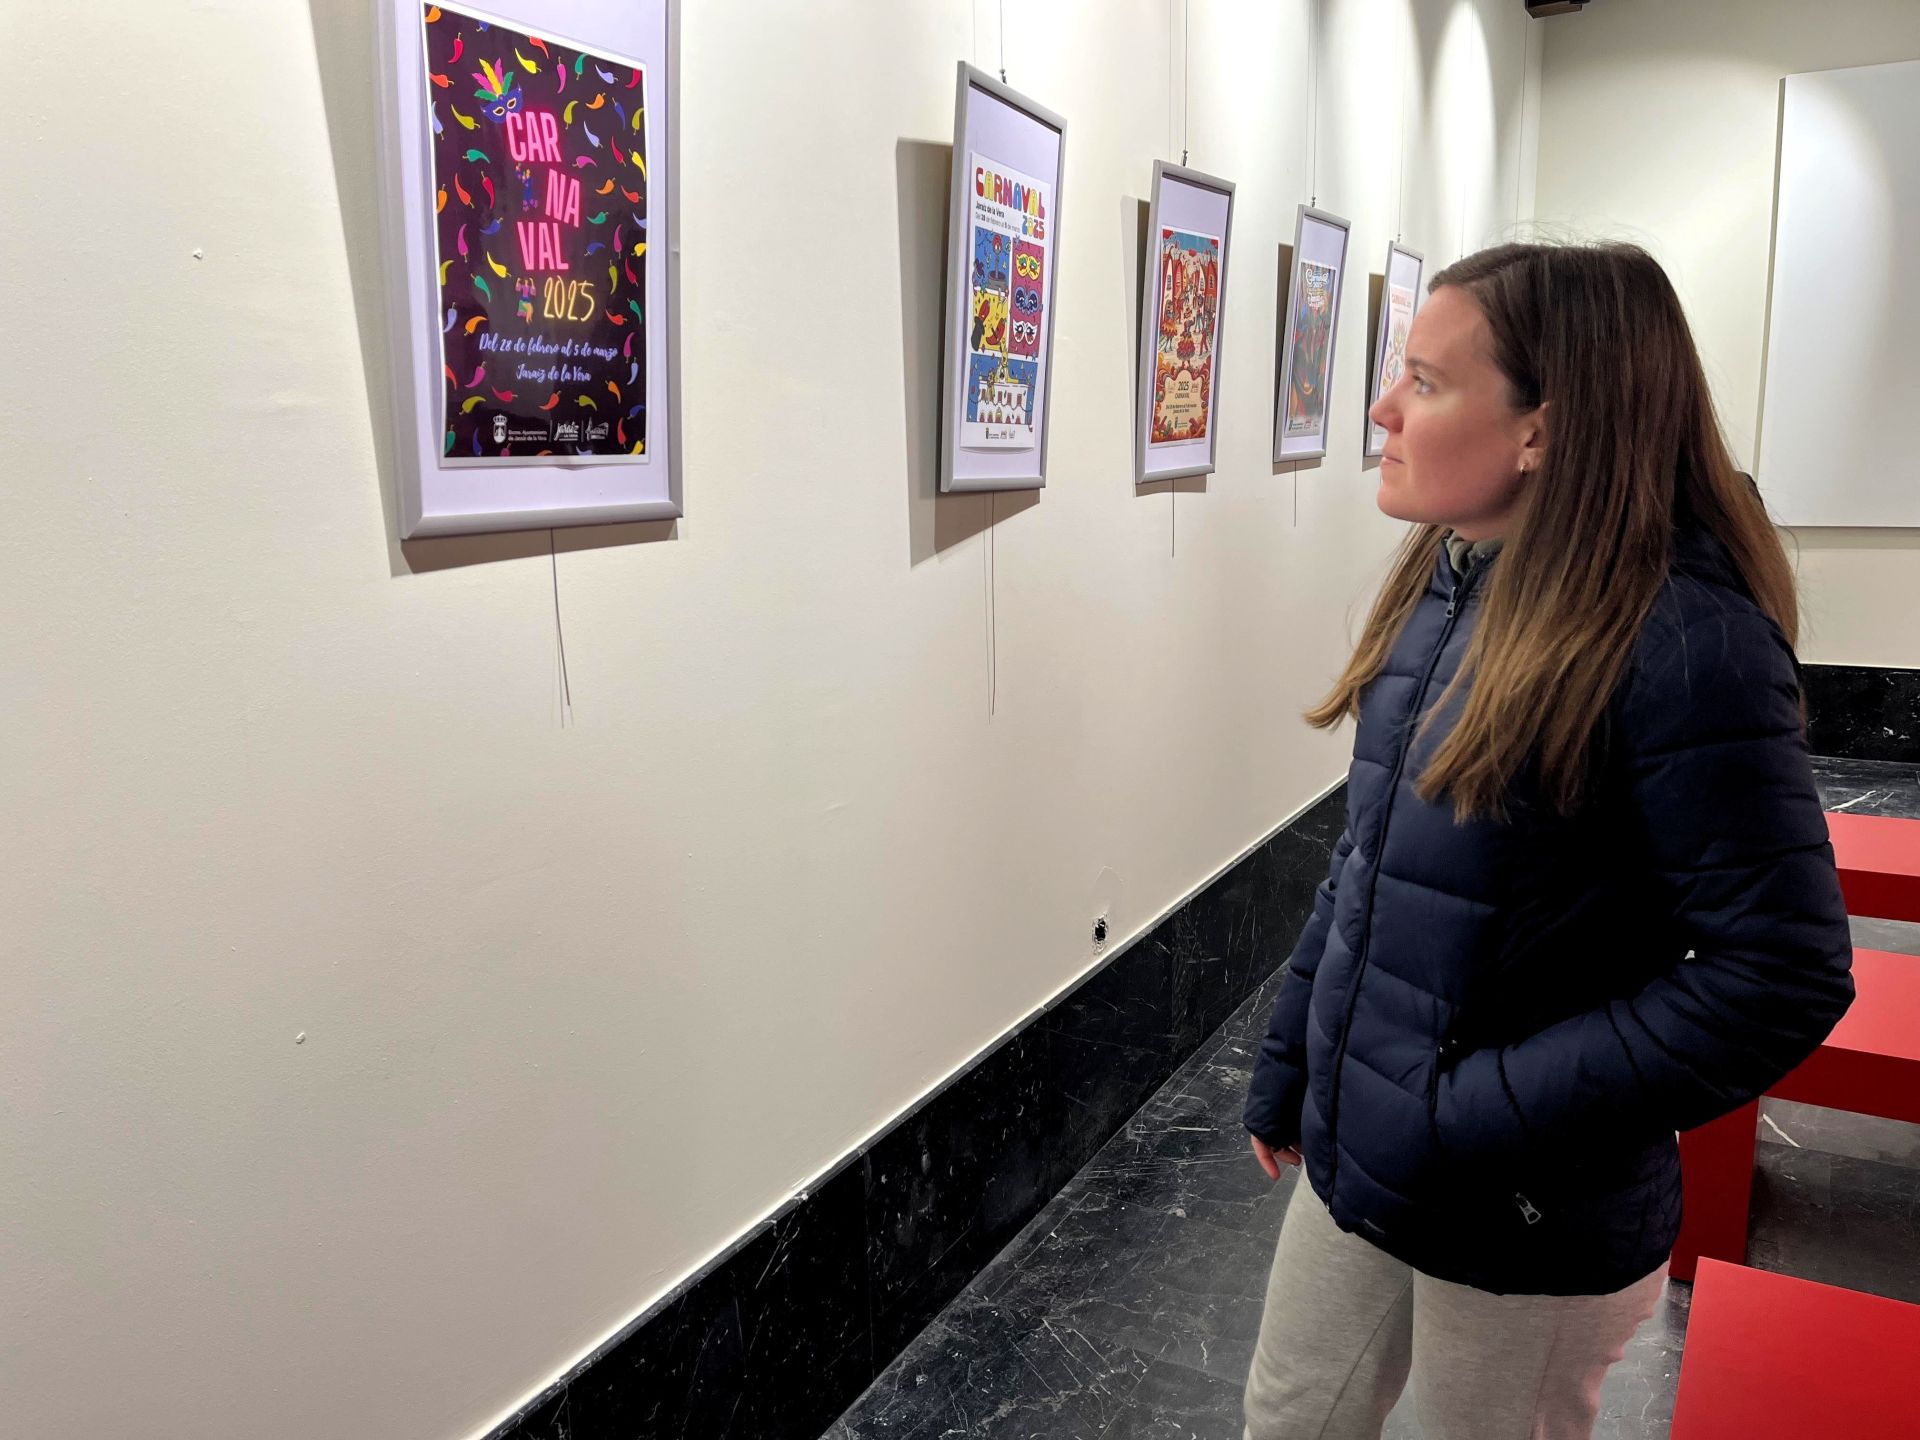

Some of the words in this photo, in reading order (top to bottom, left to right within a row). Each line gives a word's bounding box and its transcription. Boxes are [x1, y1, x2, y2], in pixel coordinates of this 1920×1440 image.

[505, 111, 562, 163] CAR
[545, 168, 581, 228] NA
[976, 166, 1045, 220] CARNAVAL
[516, 221, 570, 271] VAL
[1021, 215, 1045, 240] 2025
[543, 275, 595, 323] 2025
[479, 332, 499, 352] Del
[499, 338, 512, 351] 28
[513, 337, 527, 352] de
[527, 334, 560, 356] febrero
[560, 338, 573, 357] al
[573, 344, 580, 356] 5
[580, 341, 592, 357] de
[592, 347, 618, 361] marzo
[547, 365, 560, 380] de
[560, 363, 572, 382] la
[572, 366, 592, 382] Vera
